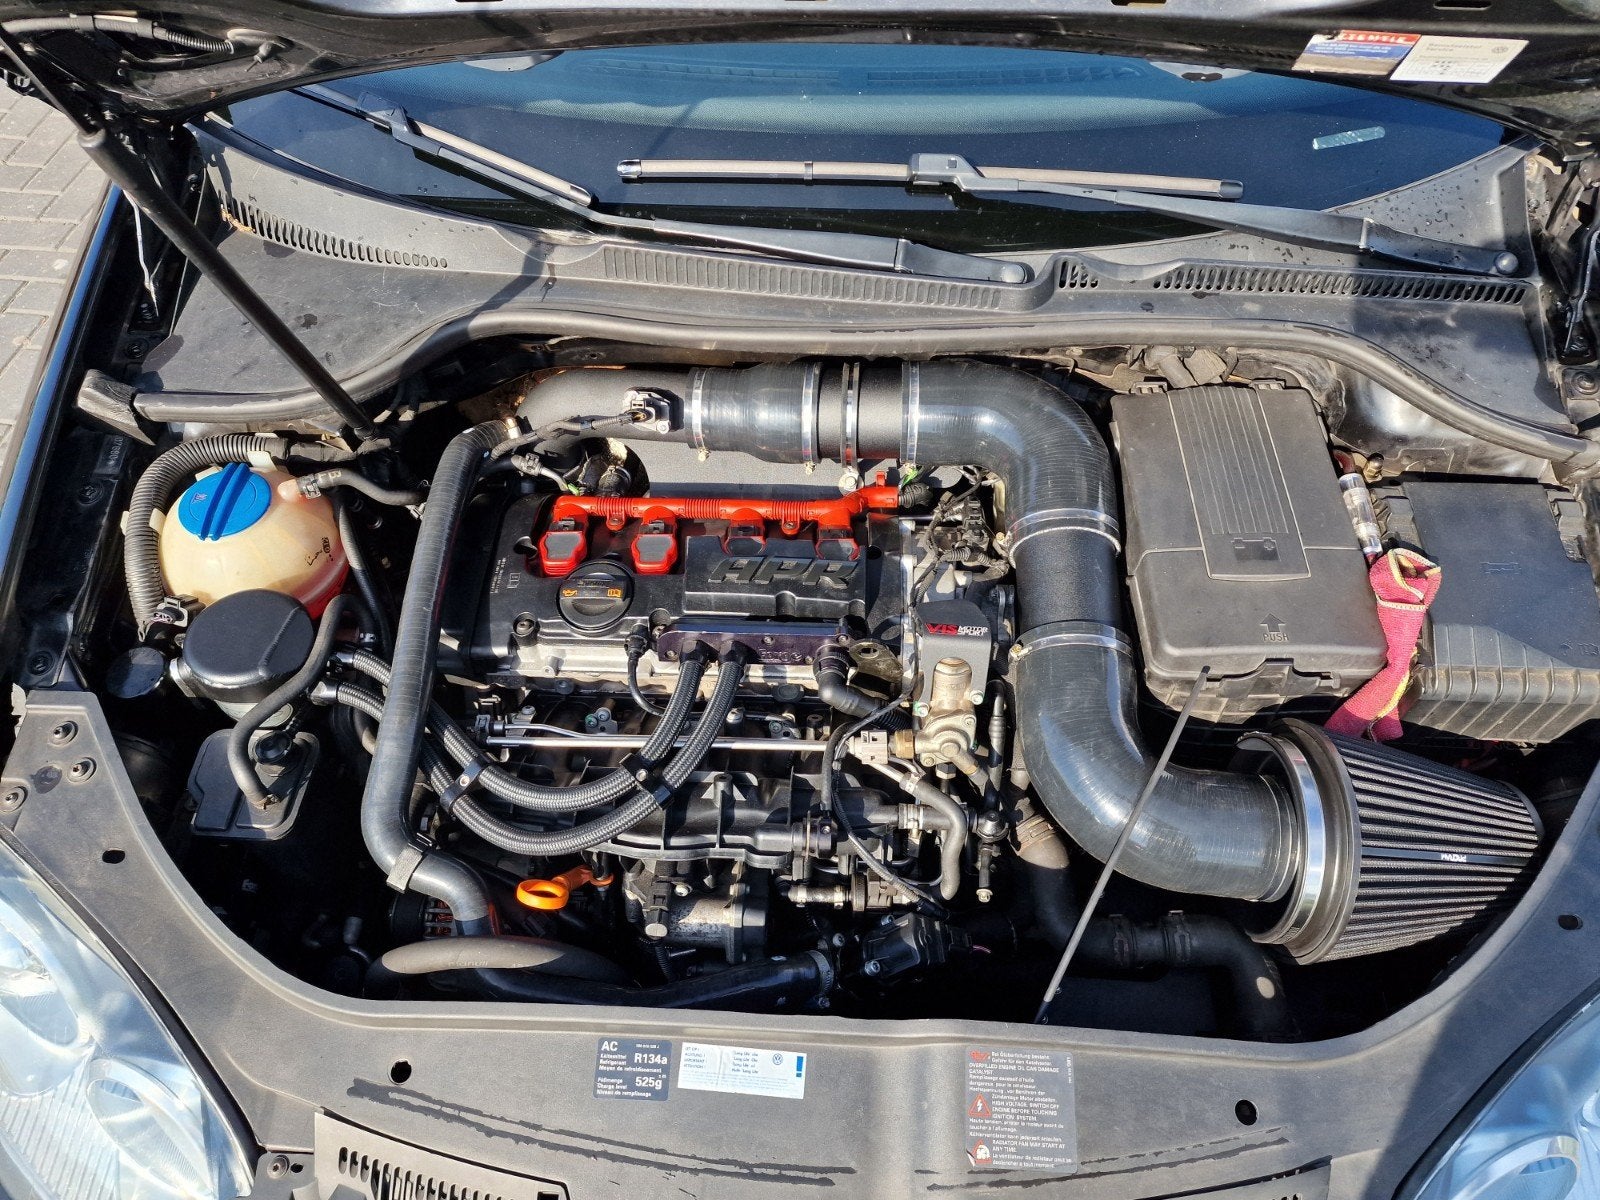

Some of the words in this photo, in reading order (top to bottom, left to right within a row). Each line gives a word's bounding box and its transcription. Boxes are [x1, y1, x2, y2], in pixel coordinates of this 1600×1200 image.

[708, 556, 858, 589] APR
[925, 623, 959, 636] VIS
[1263, 633, 1289, 641] PUSH
[601, 1041, 618, 1051] AC
[634, 1053, 668, 1064] R134a
[636, 1077, 662, 1090] 525g
